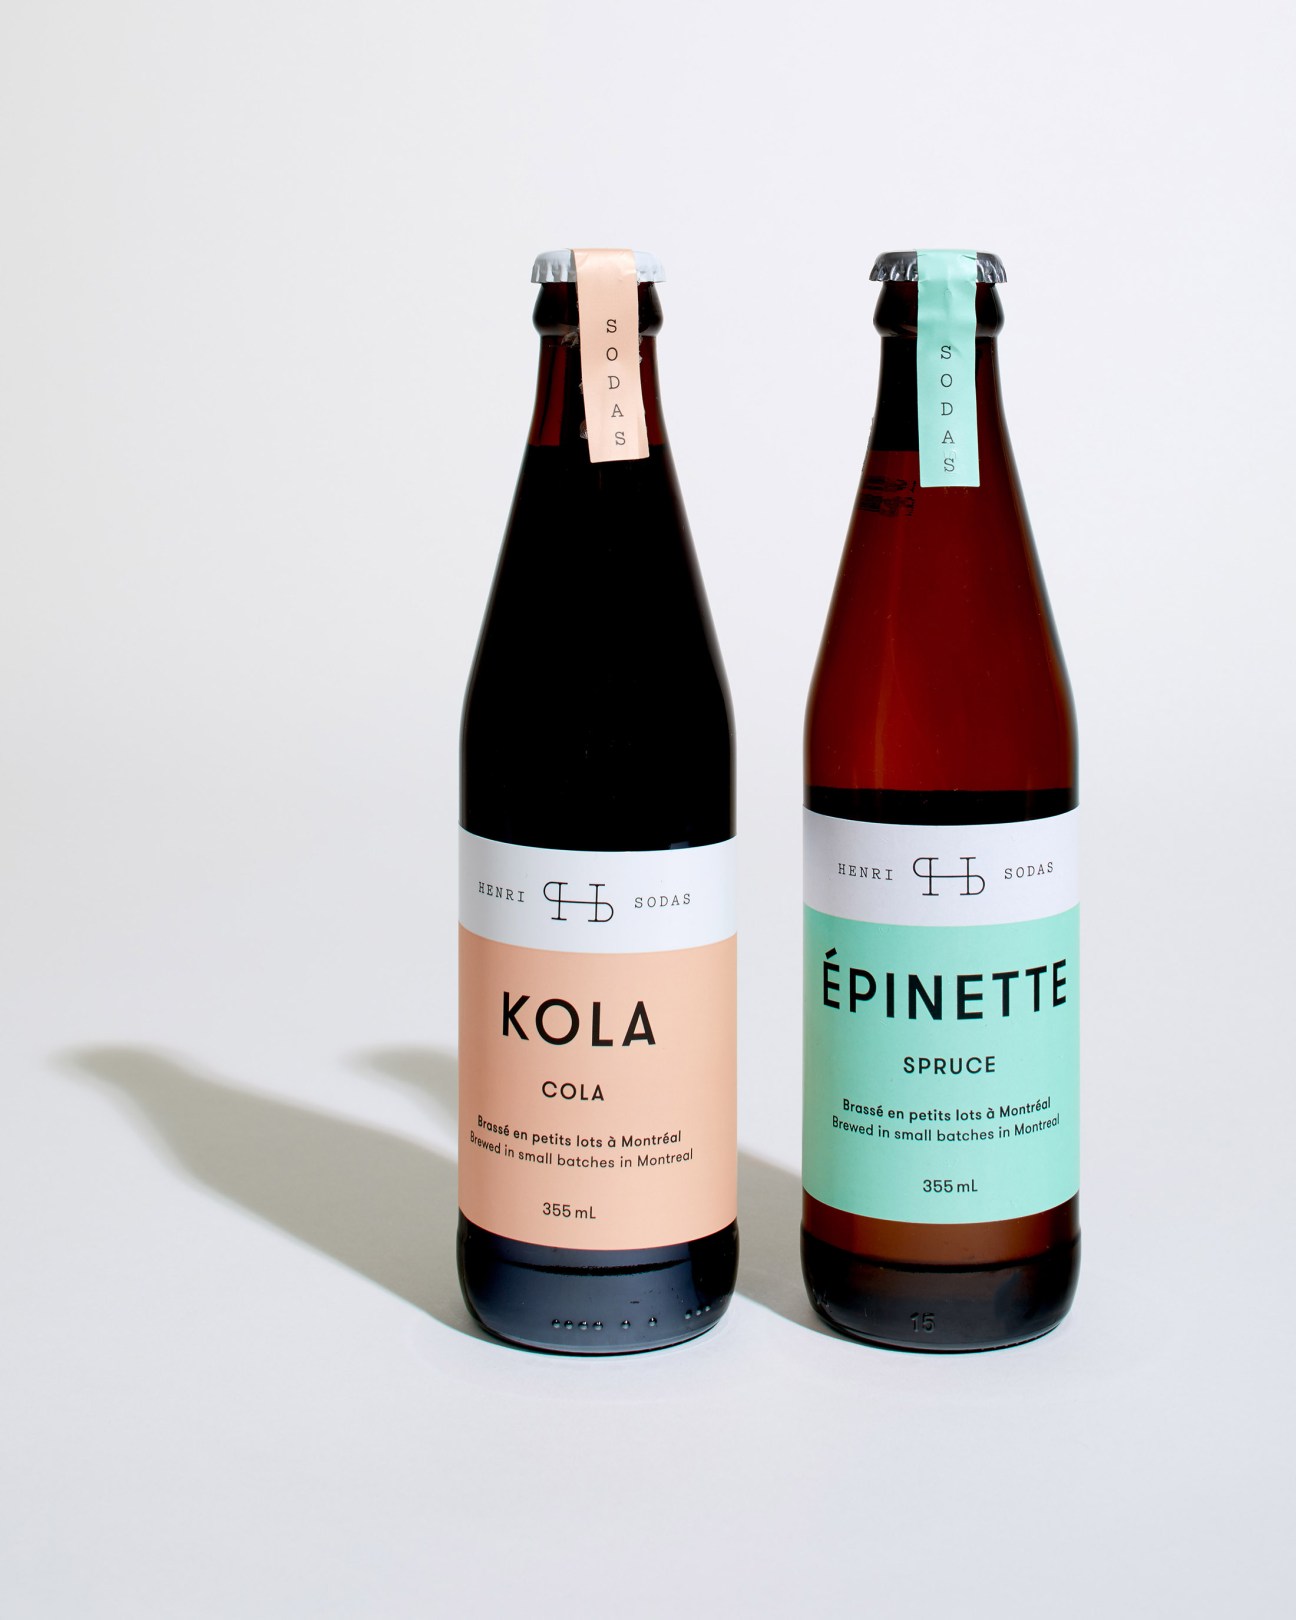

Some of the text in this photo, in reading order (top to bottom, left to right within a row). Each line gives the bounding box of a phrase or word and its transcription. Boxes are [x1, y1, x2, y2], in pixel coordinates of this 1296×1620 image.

[606, 319, 625, 445] SODAS
[941, 345, 954, 472] SODAS
[838, 863, 892, 880] HENRI
[1005, 862, 1053, 879] SODAS
[479, 881, 524, 902] HENRI
[635, 894, 690, 908] SODAS
[823, 947, 1066, 1020] ÉPINETTE
[503, 991, 656, 1046] KOLA
[904, 1056, 995, 1075] SPRUCE
[542, 1081, 604, 1101] COLA
[843, 1096, 1050, 1122] Brassé en petits lots à Montréal
[478, 1114, 681, 1148] Brassé en petits lots à Montréal
[833, 1112, 1059, 1141] Brewed in small batches in Montreal
[470, 1129, 692, 1168] Brewed in small batches in Montreal
[923, 1179, 978, 1193] 355 mL
[543, 1202, 596, 1219] 355 mL
[910, 1312, 936, 1334] 15
